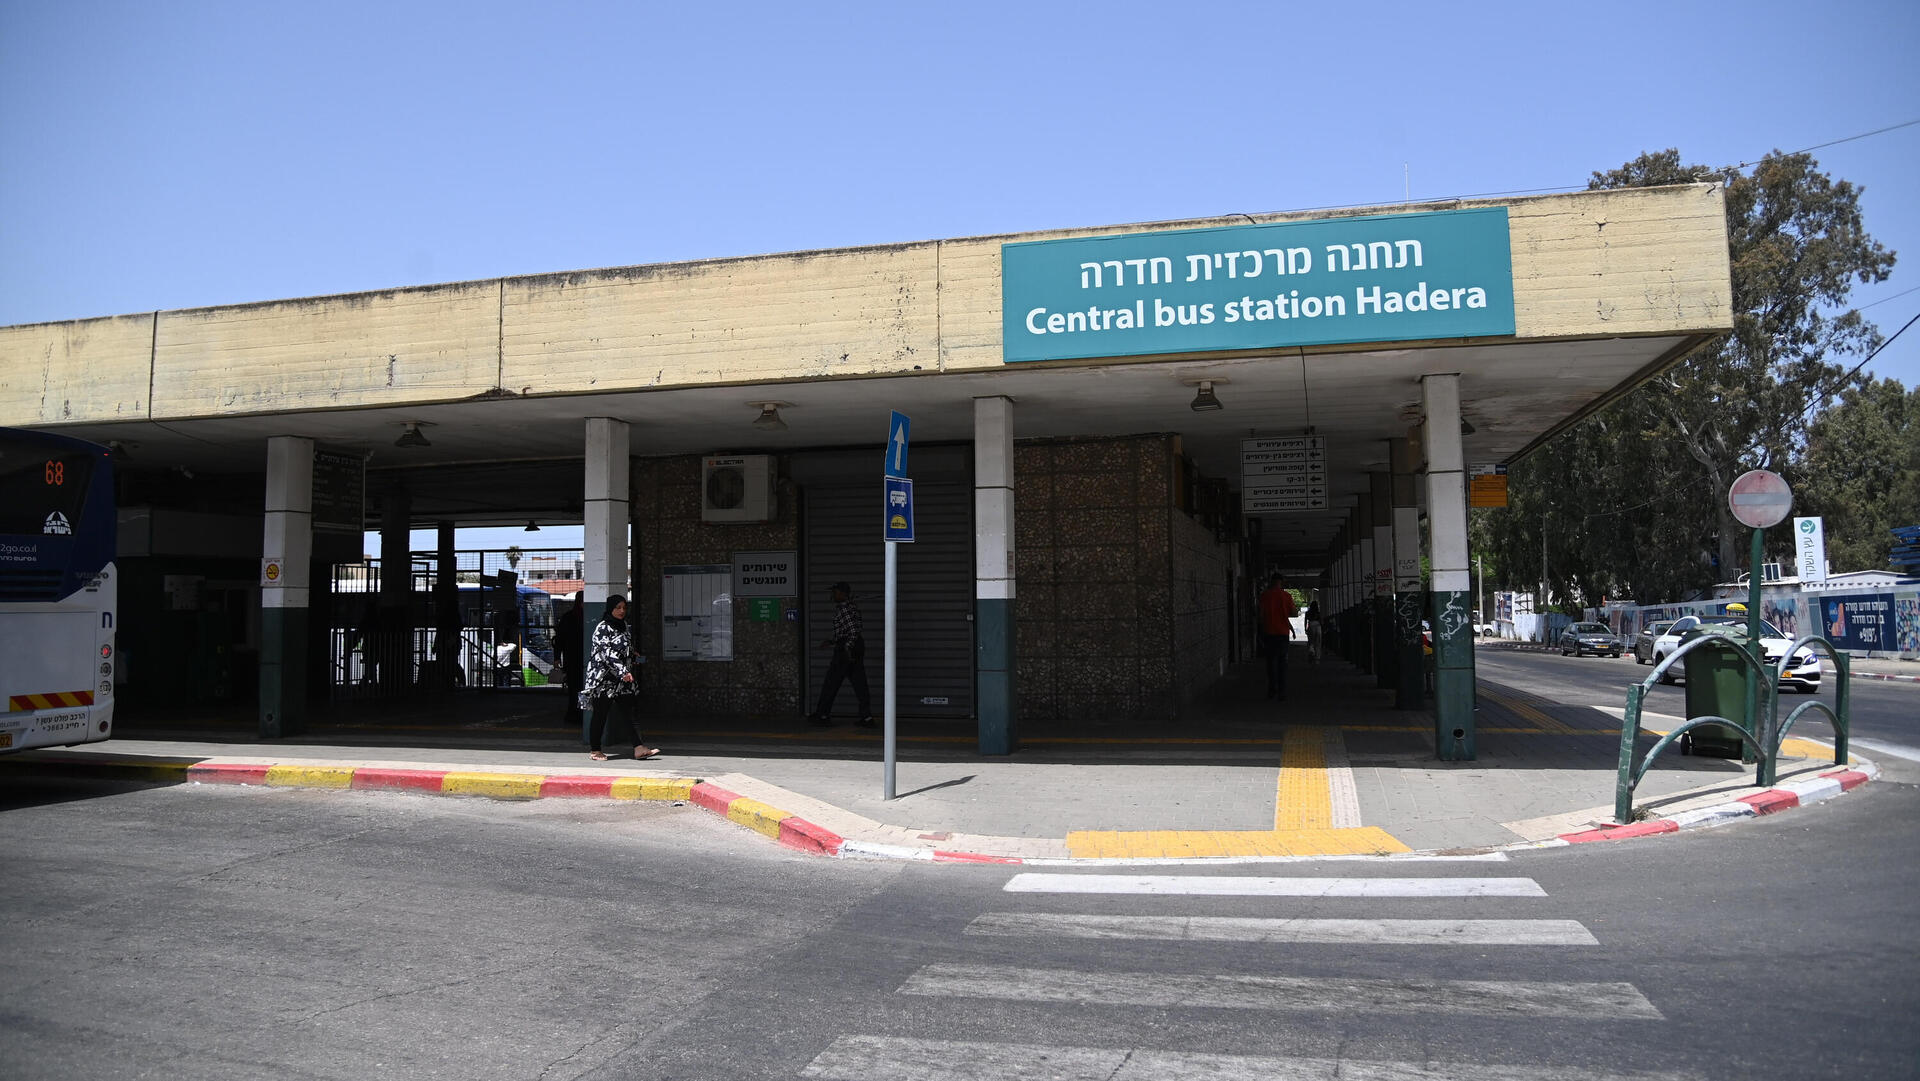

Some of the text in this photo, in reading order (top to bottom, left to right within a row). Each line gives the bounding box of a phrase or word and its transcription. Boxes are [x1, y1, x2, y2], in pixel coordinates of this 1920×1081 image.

[1080, 239, 1423, 289] תחנה מרכזית חדרה
[1026, 281, 1487, 335] Central bus station Hadera
[45, 460, 64, 486] 68
[742, 563, 787, 572] שירותים
[1803, 536, 1817, 579] עץ השקד
[742, 576, 787, 585] מונגשים
